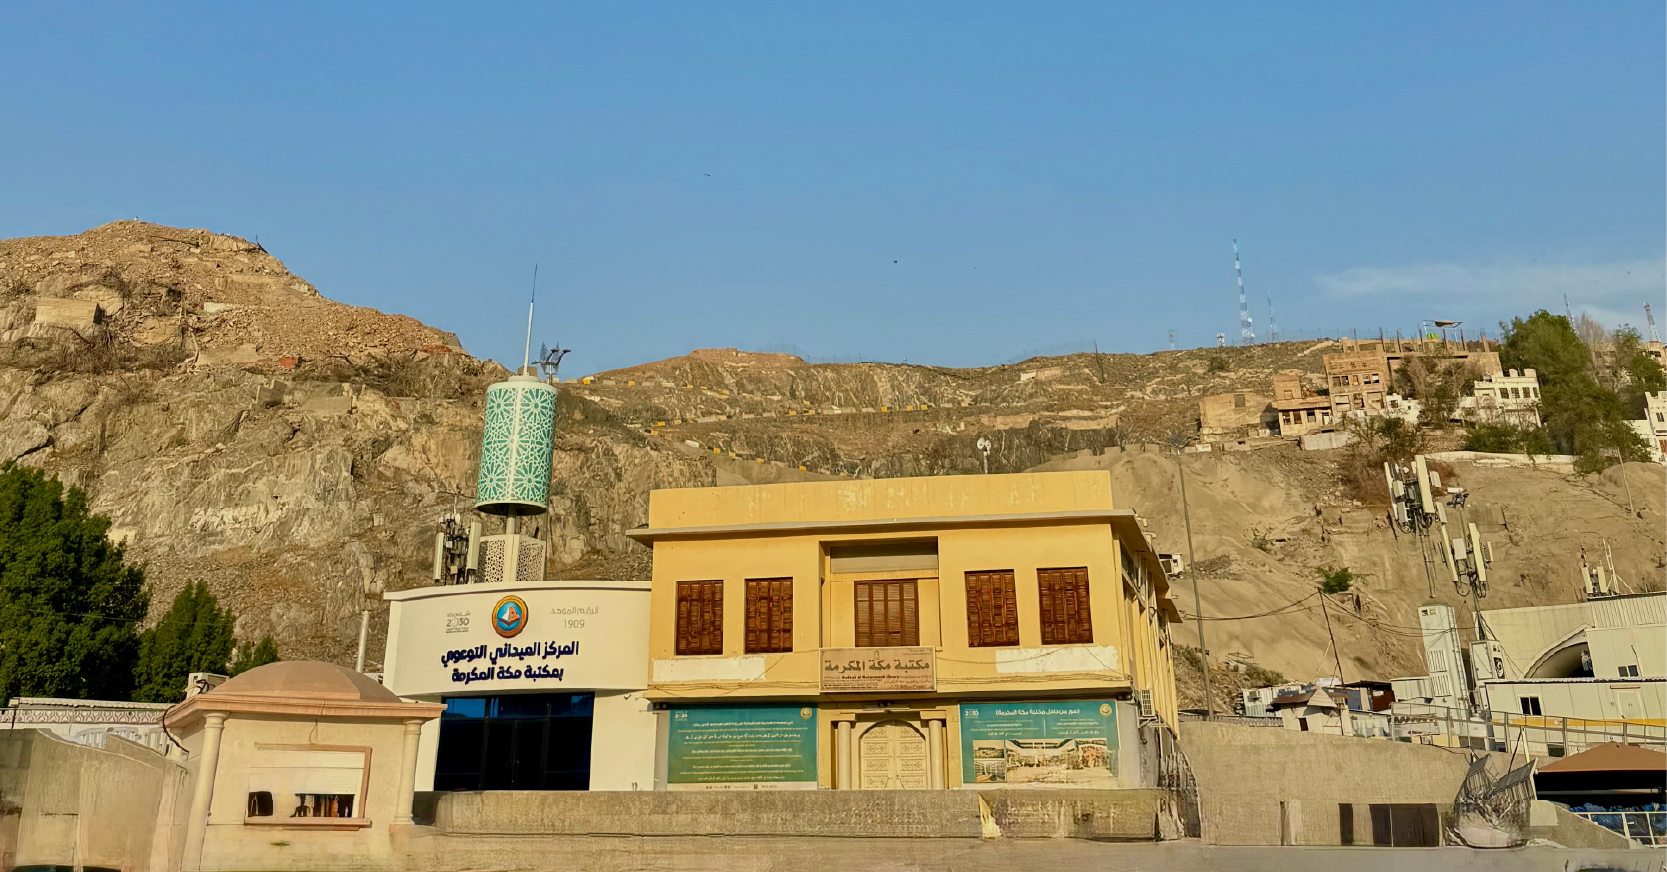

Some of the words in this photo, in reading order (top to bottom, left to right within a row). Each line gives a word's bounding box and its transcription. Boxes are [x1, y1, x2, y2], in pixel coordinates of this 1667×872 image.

[550, 606, 577, 616] الموحد
[577, 606, 599, 616] الرقم
[445, 617, 470, 628] 2030
[563, 619, 585, 629] 1909
[441, 644, 487, 668] التوعوي
[489, 642, 541, 665] الميداني
[541, 641, 579, 660] المركز
[496, 665, 522, 680] مكة
[824, 659, 866, 674] المكرمة
[868, 659, 891, 671] مكة
[893, 659, 930, 674] مكتبة
[451, 666, 495, 685] المكرمة
[524, 664, 564, 682] بمكتبة
